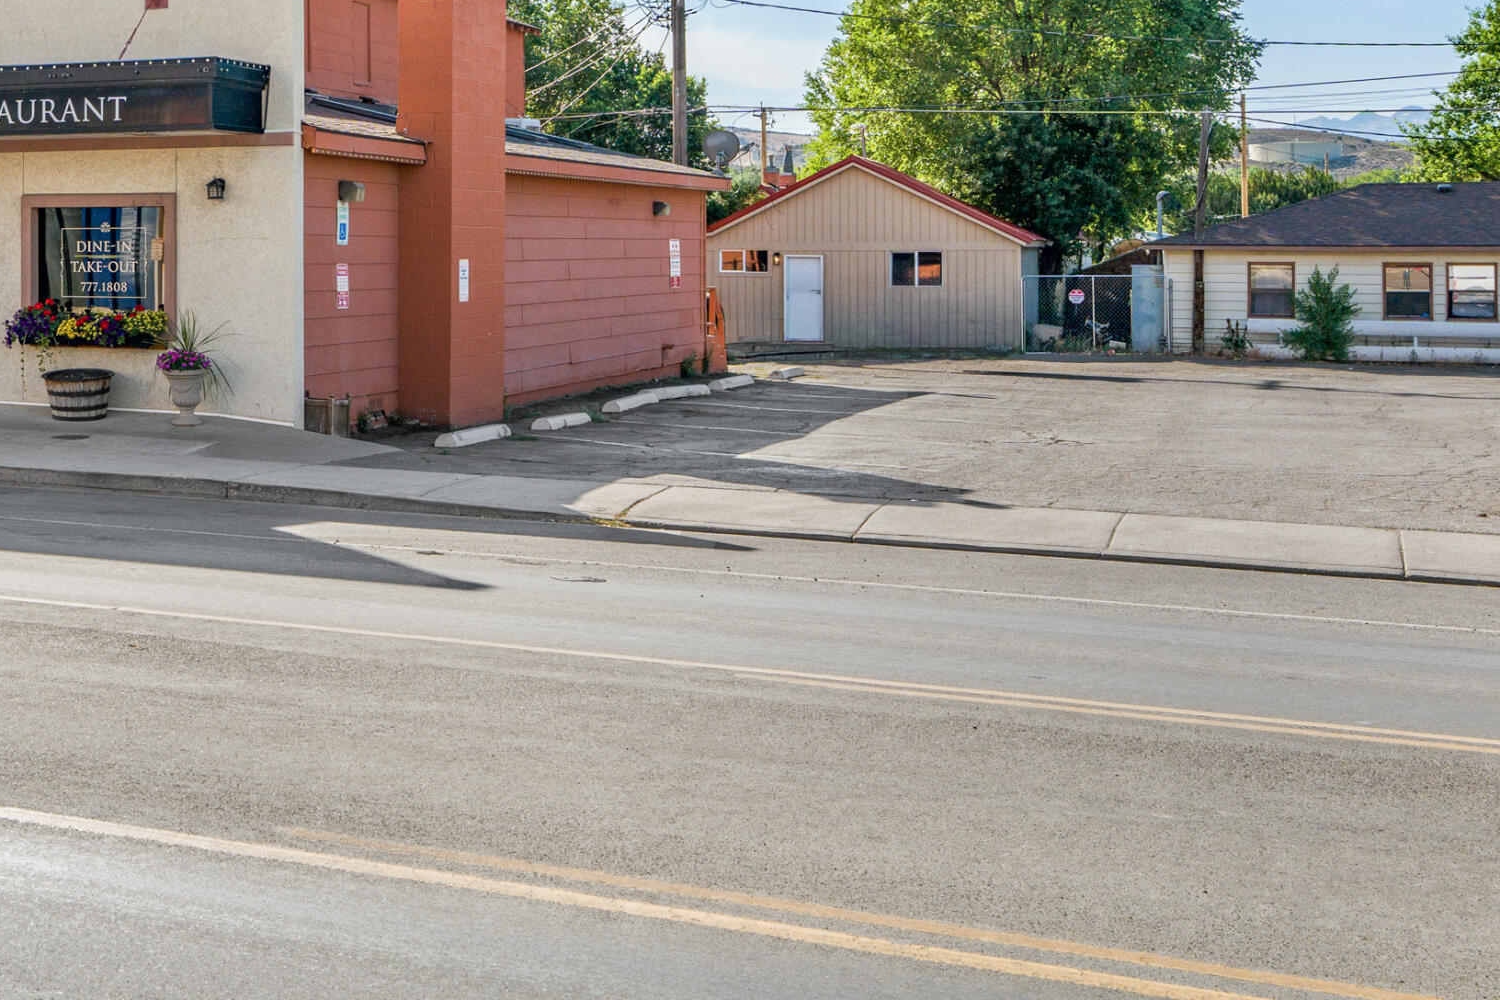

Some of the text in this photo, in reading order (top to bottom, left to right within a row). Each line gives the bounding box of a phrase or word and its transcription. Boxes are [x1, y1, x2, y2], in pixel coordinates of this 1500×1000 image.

[76, 240, 132, 253] DINE-IN
[70, 261, 138, 273] TAKE-OUT
[80, 281, 128, 292] 777.1808
